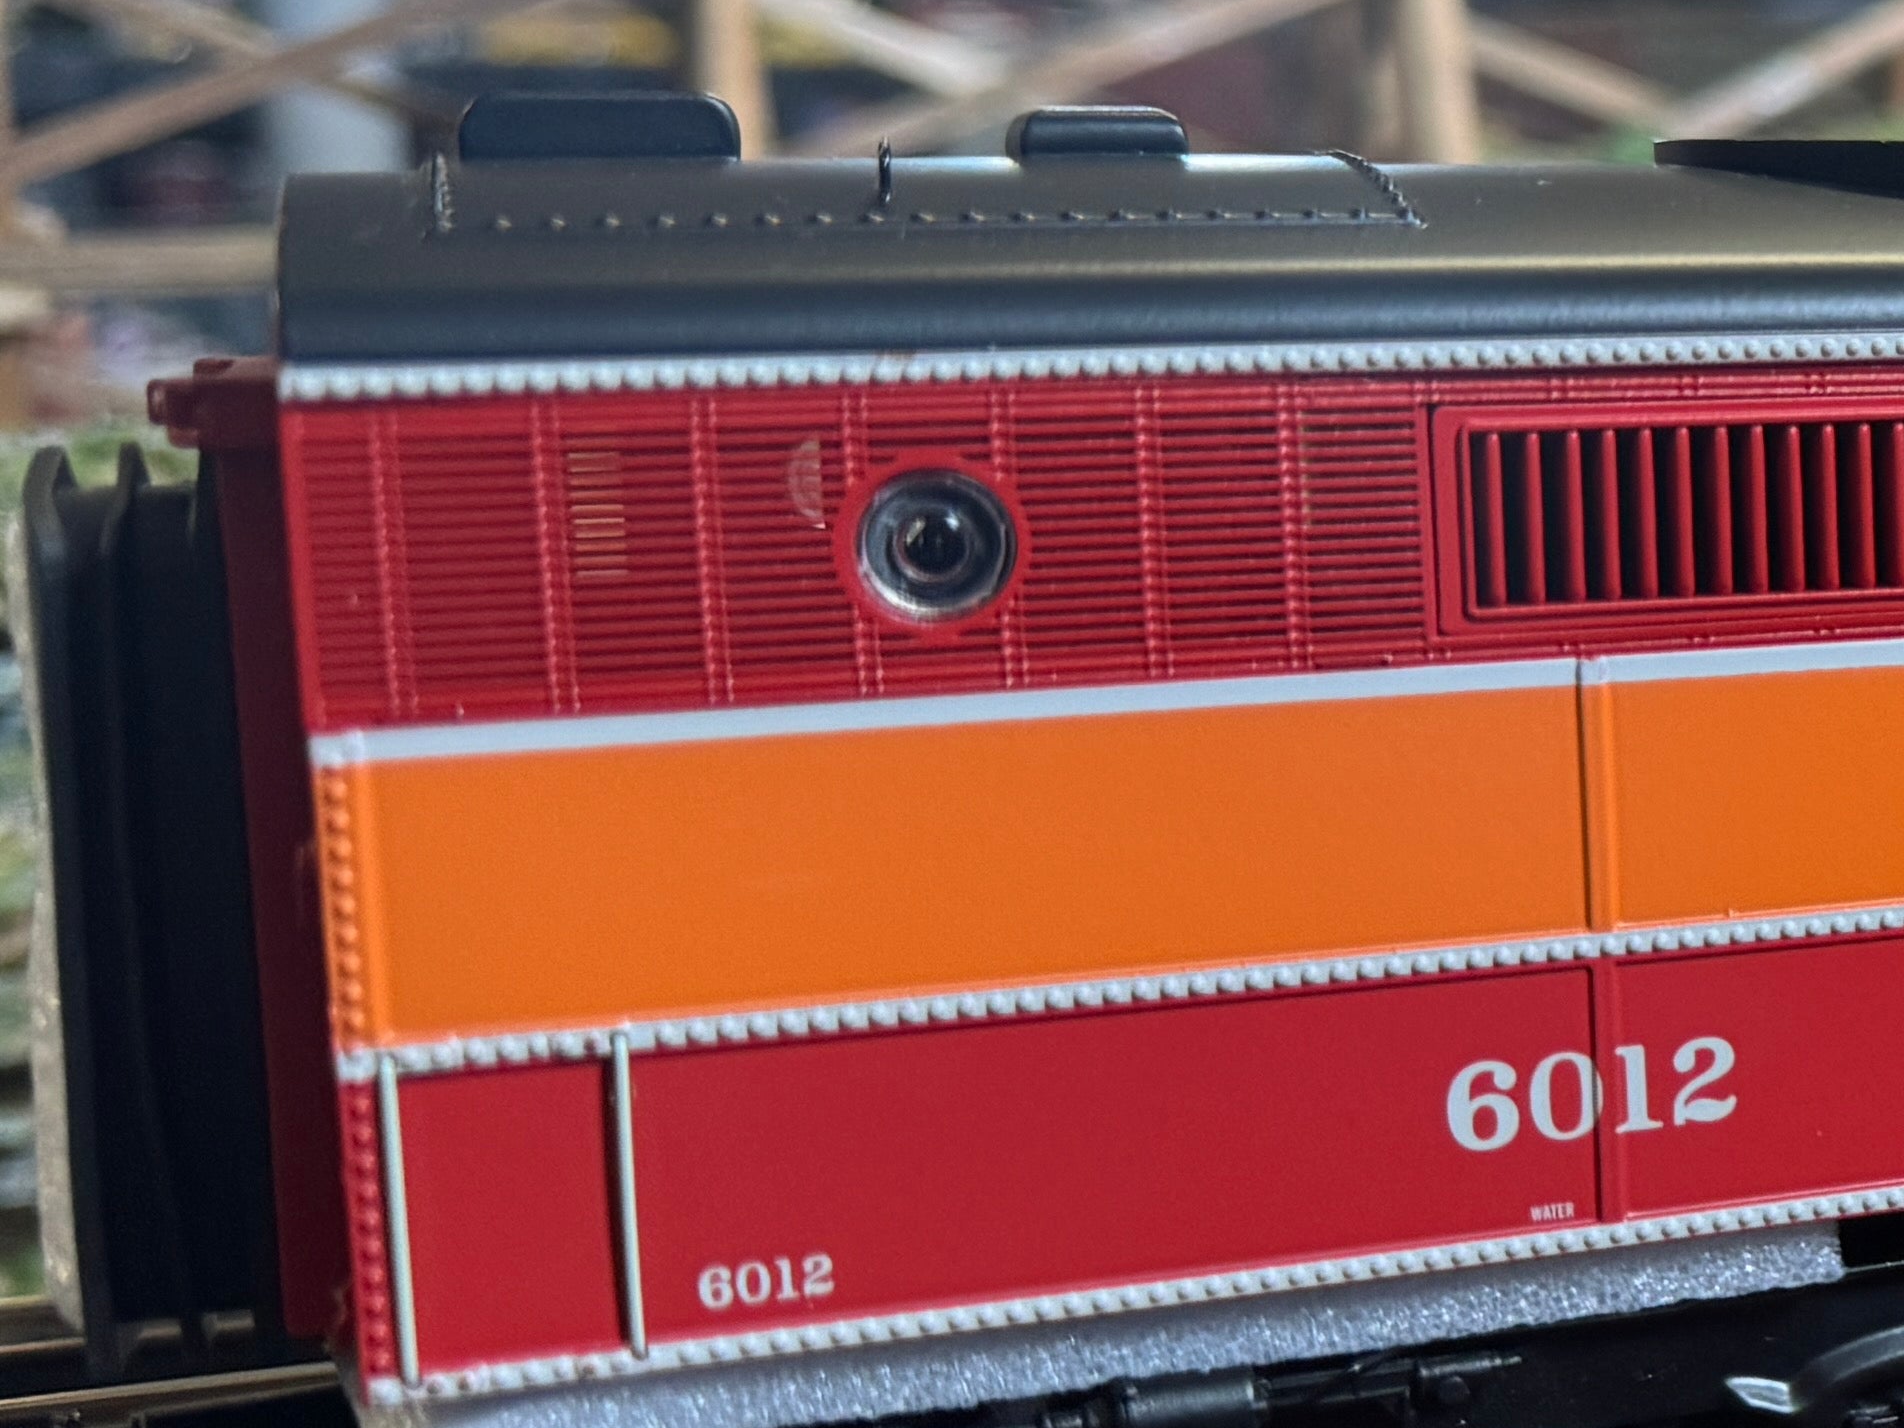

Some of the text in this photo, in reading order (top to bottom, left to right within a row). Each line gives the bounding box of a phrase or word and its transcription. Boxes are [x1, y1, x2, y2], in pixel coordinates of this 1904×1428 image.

[1446, 1036, 1737, 1152] 6012
[1530, 1202, 1575, 1221] WATER
[698, 1254, 834, 1309] 6012
